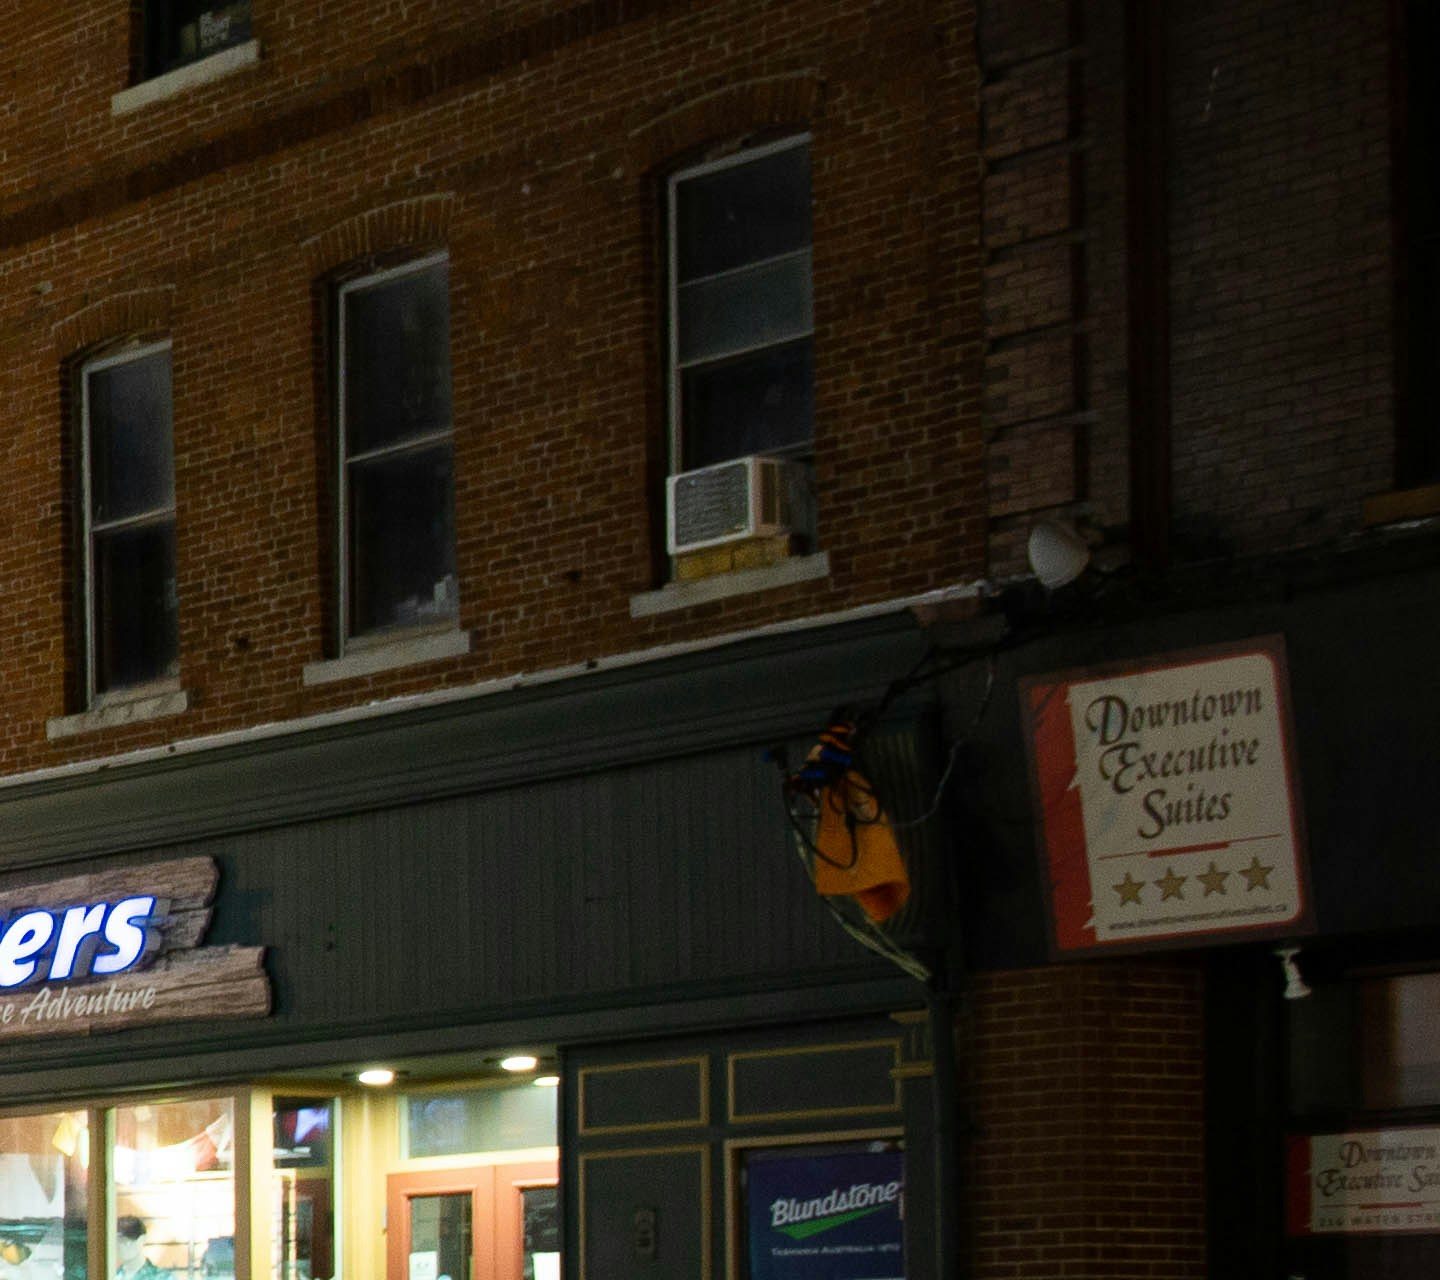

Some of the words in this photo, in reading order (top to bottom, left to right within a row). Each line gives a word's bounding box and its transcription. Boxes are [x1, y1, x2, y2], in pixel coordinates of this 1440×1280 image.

[1085, 686, 1264, 746] Downtown
[1098, 728, 1261, 794] Executive
[1137, 783, 1234, 840] Suites
[20, 983, 157, 1025] Adventure
[1339, 1141, 1436, 1169] Downtown
[769, 1180, 899, 1227] Blundstone
[1315, 1168, 1403, 1198] Executive
